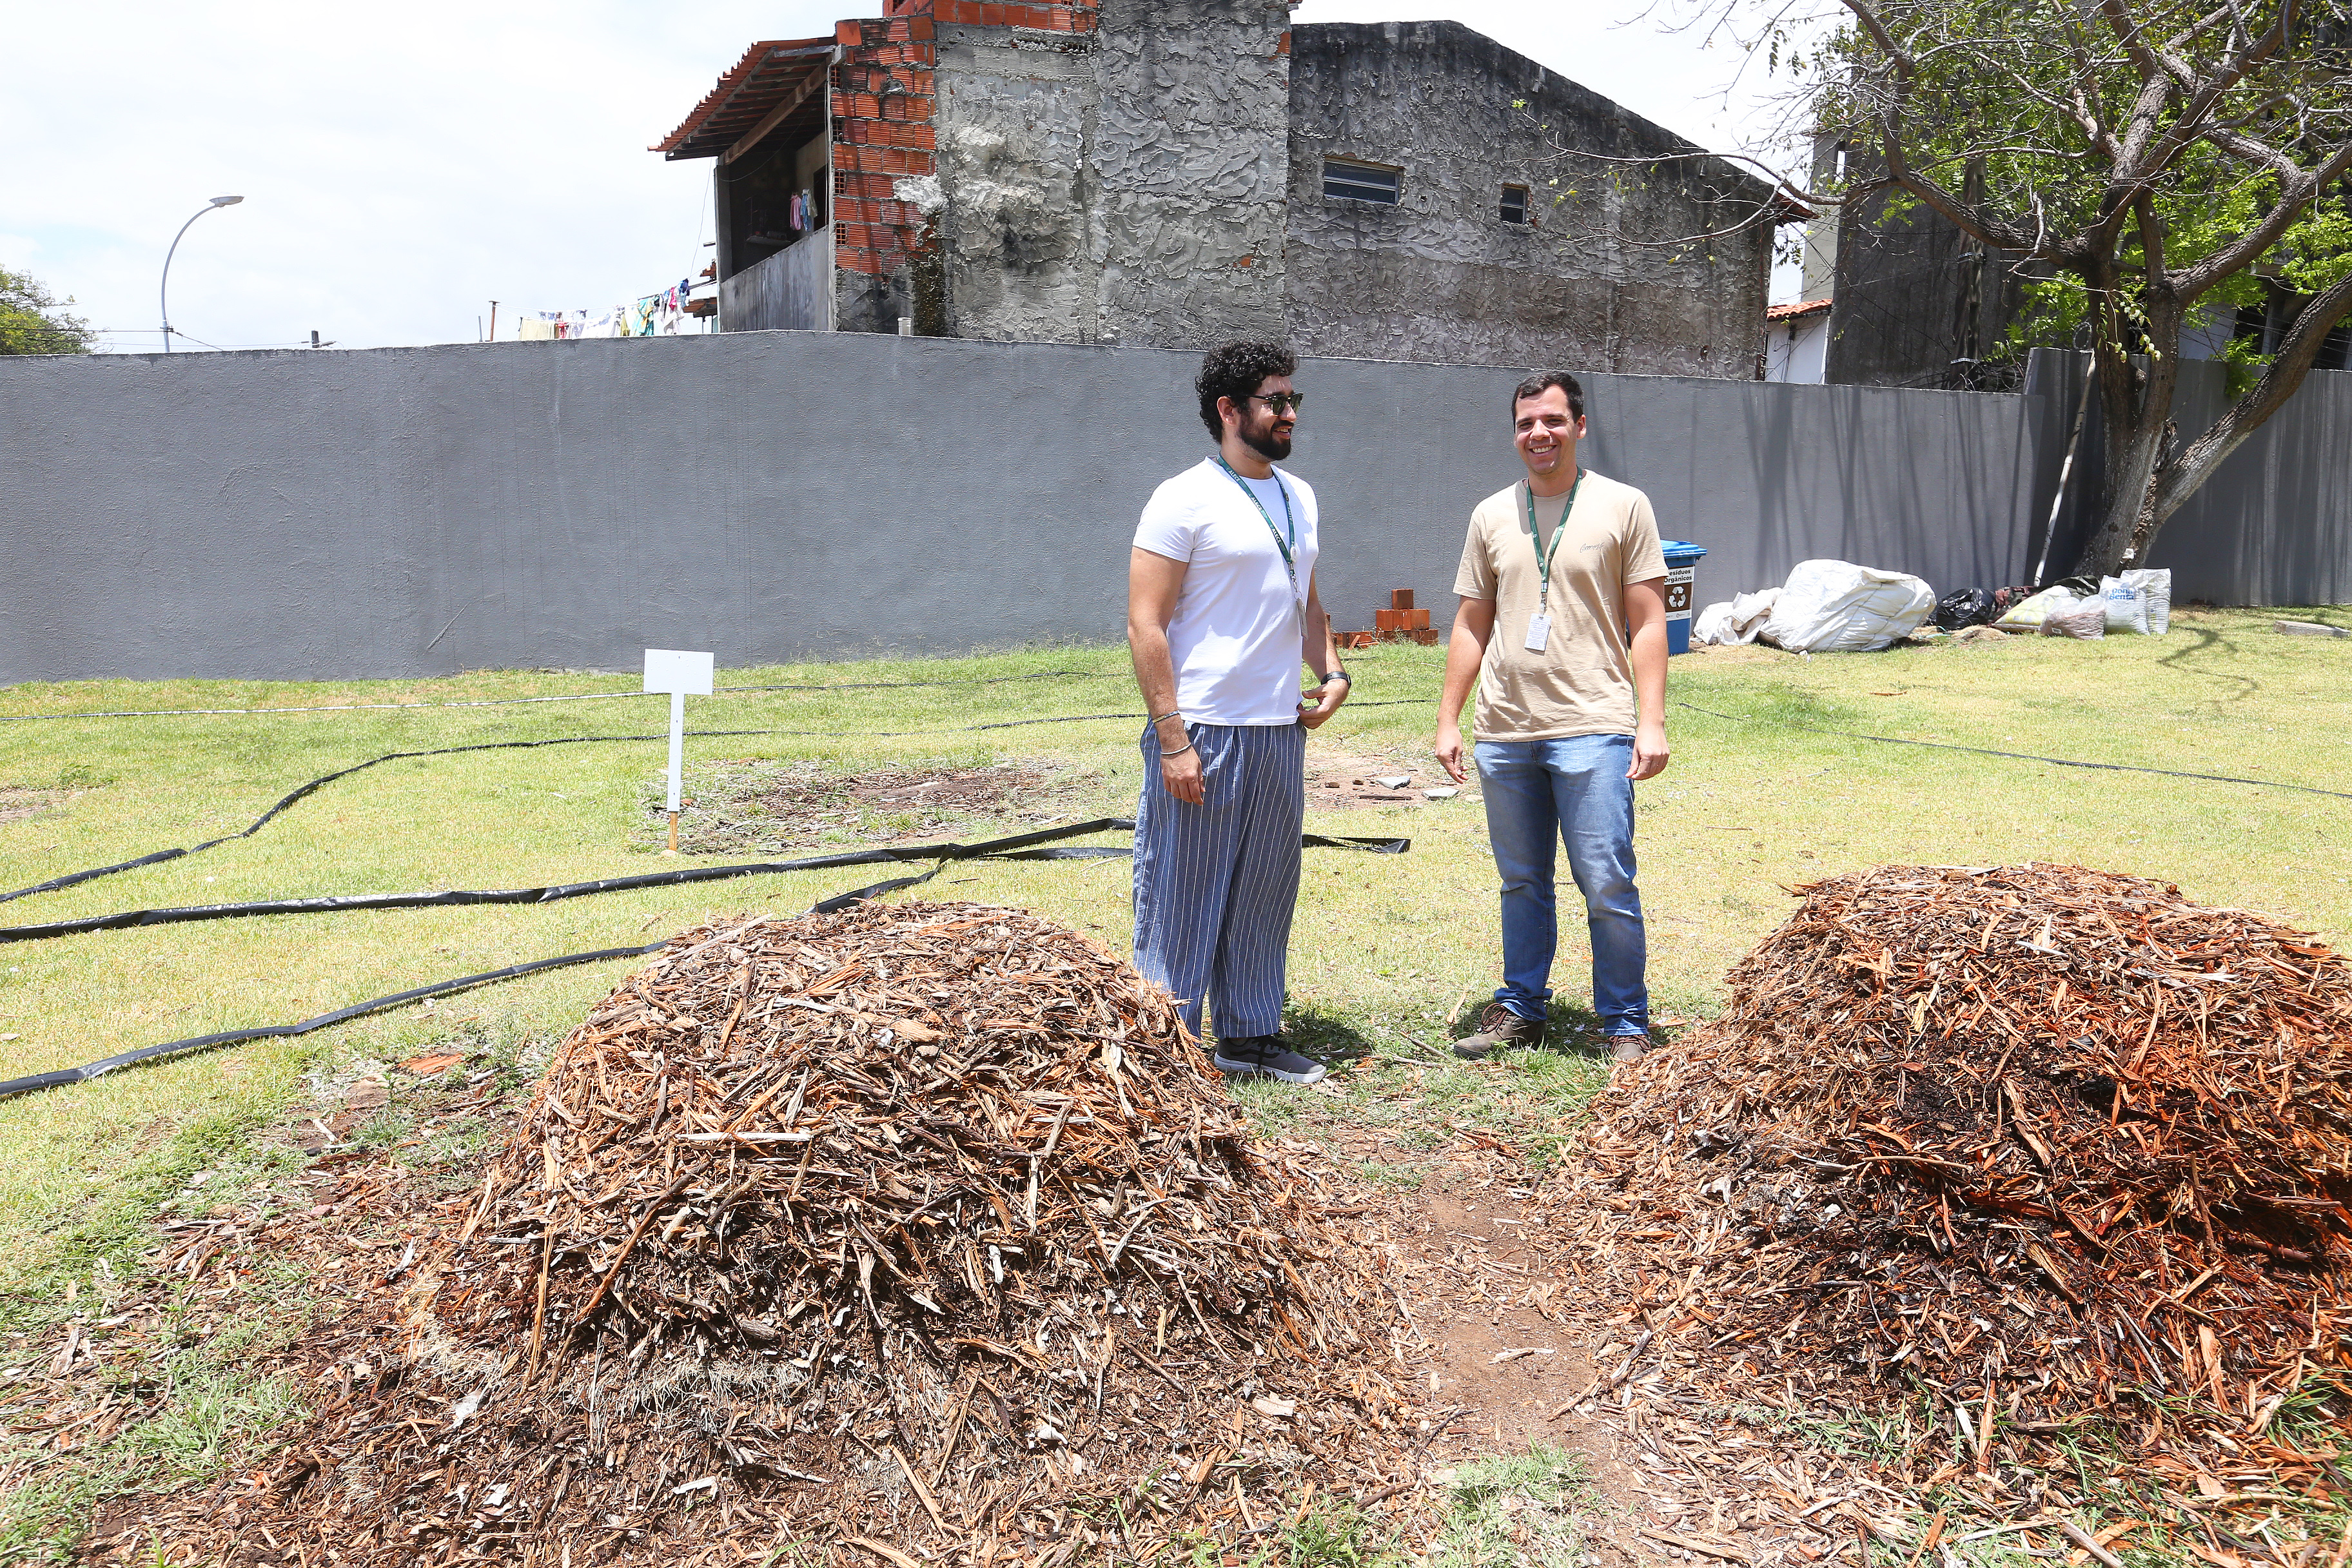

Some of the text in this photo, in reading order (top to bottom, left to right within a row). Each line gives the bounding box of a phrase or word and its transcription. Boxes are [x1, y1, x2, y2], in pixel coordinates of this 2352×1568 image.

[1228, 469, 1242, 482] ALECE
[1250, 497, 1264, 511] ALECE
[1271, 528, 1282, 544] ALECE
